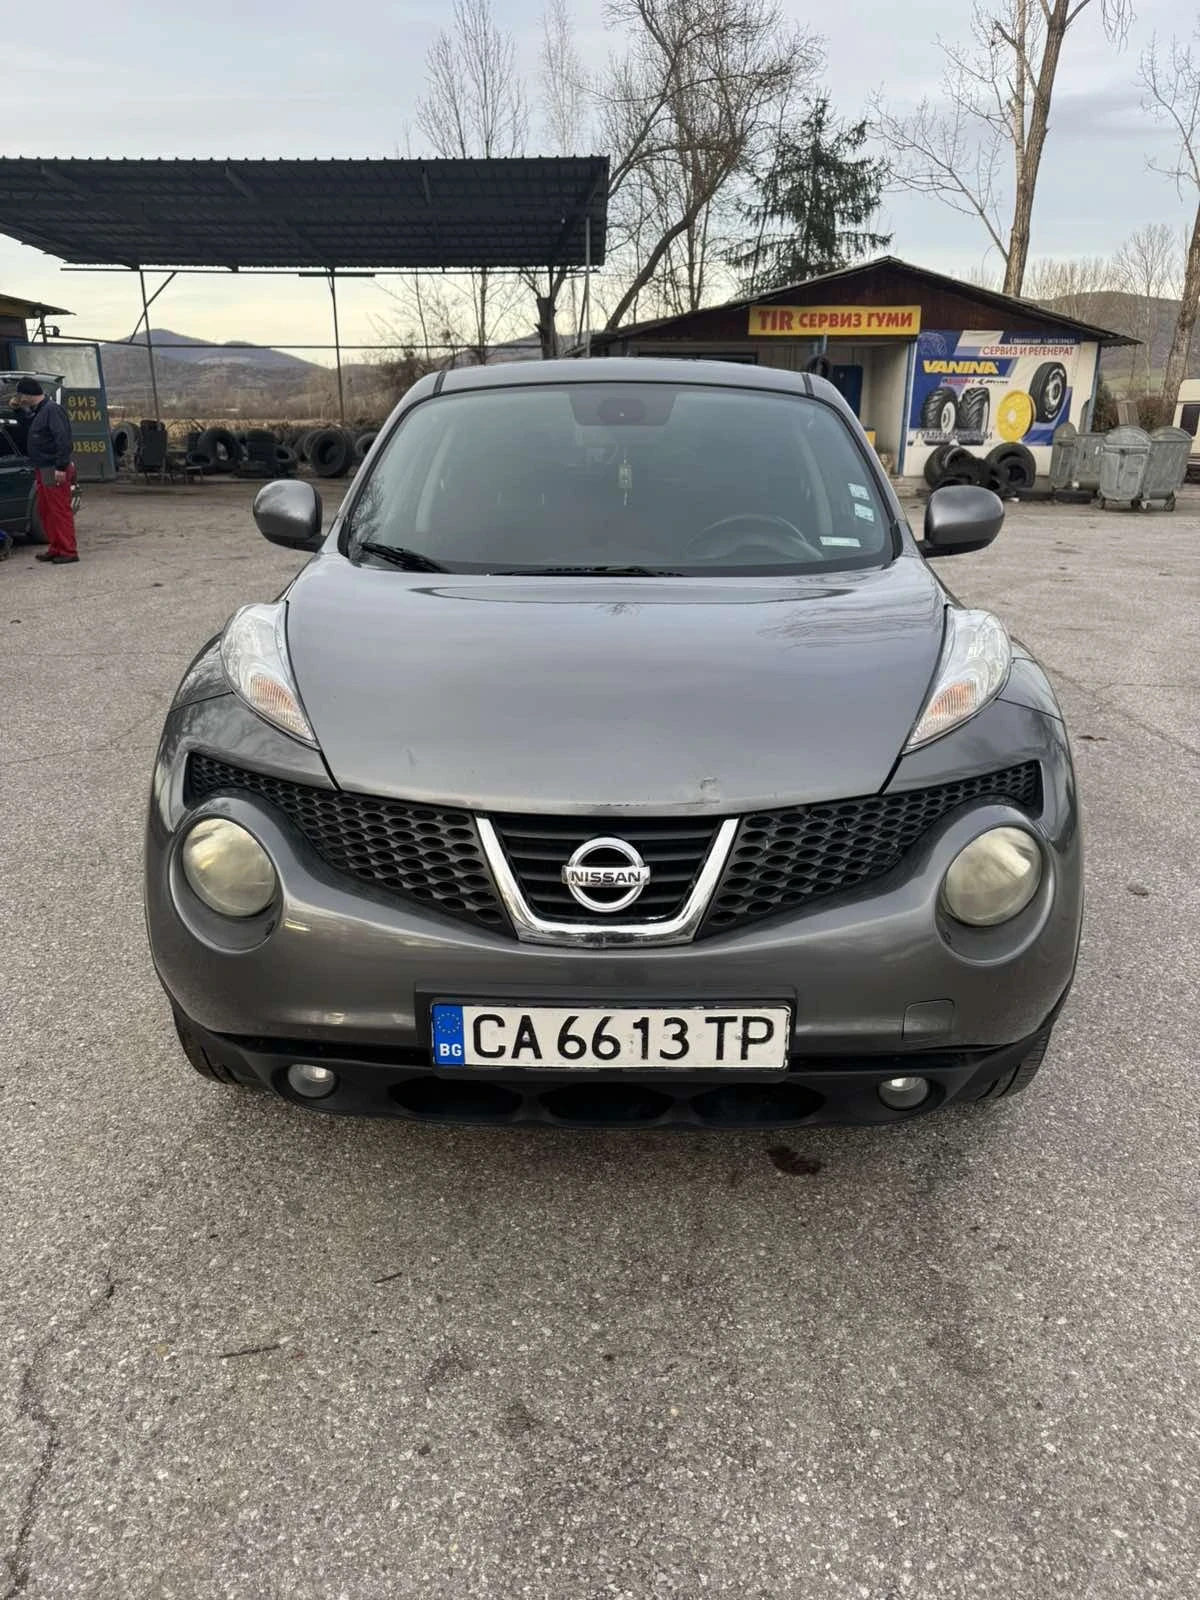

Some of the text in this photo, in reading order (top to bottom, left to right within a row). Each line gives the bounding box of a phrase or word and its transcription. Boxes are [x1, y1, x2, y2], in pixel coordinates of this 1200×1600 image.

[758, 310, 913, 330] TIR СЕРВИЗ ГУМИ
[983, 346, 1018, 356] СЕРВИЗ
[1029, 346, 1074, 356] РЕГЕНЕРАТ
[923, 360, 999, 374] VANINA
[571, 871, 641, 884] NISSAN
[472, 1013, 776, 1061] CA 6613 TP
[439, 1043, 463, 1058] BG
